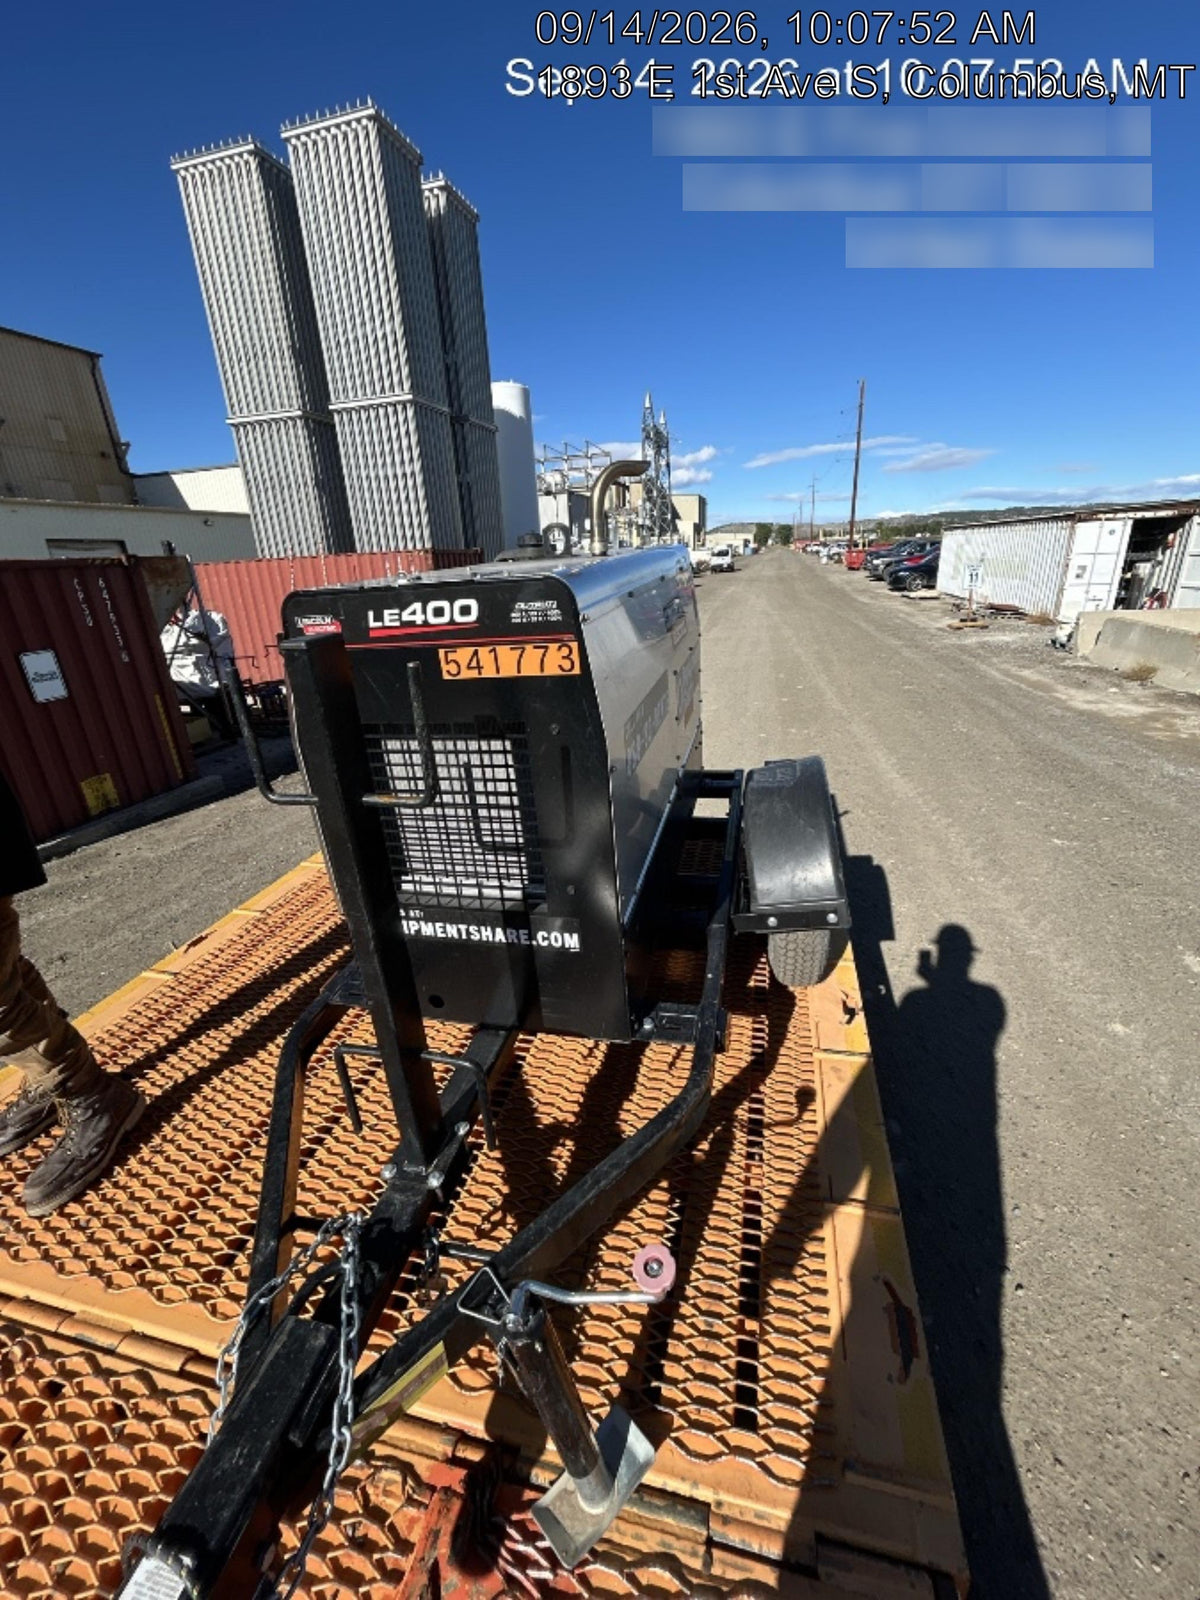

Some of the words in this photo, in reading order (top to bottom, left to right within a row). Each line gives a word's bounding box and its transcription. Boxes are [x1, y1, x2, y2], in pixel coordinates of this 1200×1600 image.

[367, 598, 479, 628] LE400
[442, 642, 576, 678] 541773
[401, 919, 580, 950] IPMENTSHARE.COM
